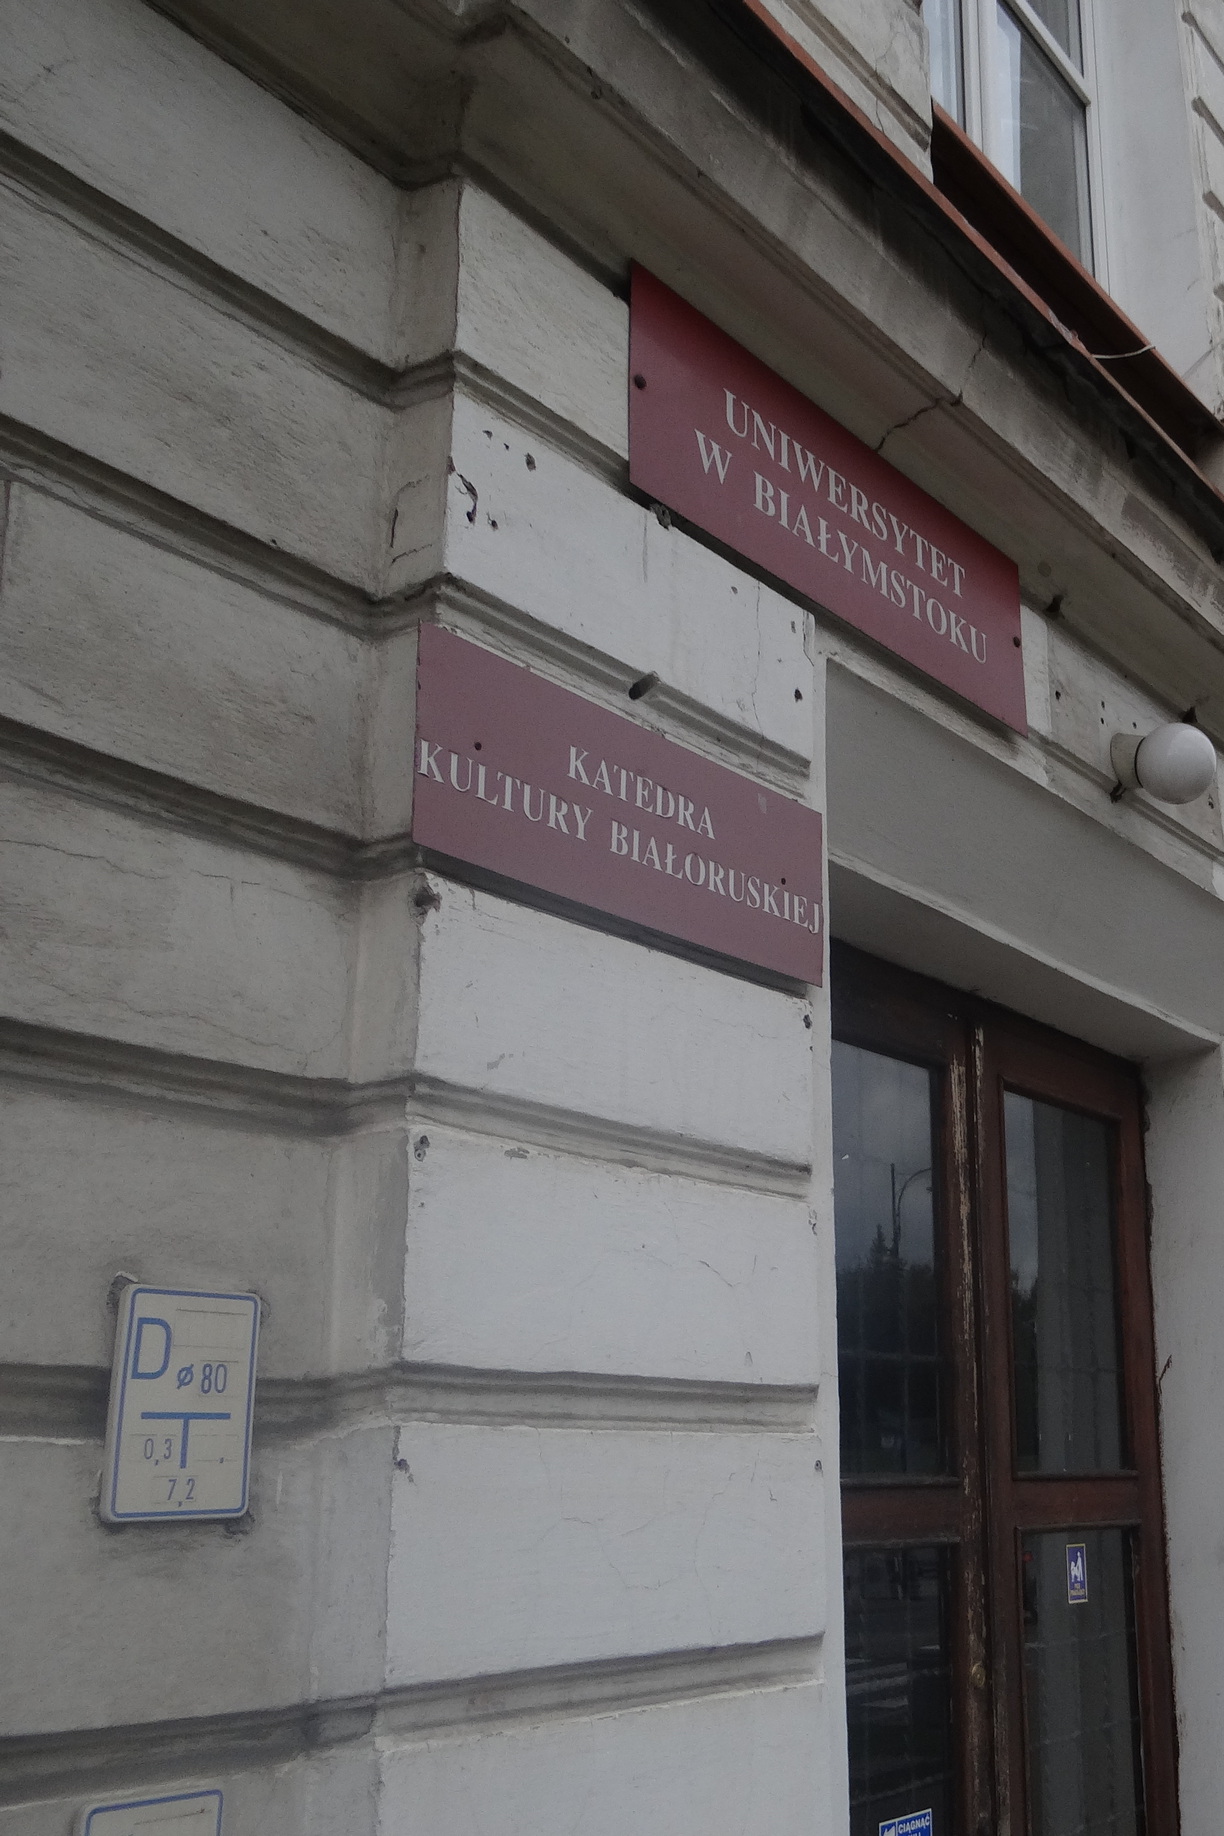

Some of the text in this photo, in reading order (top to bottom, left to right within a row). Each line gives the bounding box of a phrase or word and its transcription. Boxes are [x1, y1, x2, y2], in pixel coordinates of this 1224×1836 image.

[694, 428, 988, 664] W BIAŁYMSTOKU
[723, 387, 967, 597] UNIWERSYTET
[417, 738, 821, 935] KULTURY BIAŁORUSKIEJ
[567, 744, 716, 840] KATEDRA
[131, 1317, 172, 1380] D
[898, 1812, 930, 1834] CIĄGNĄĆ
